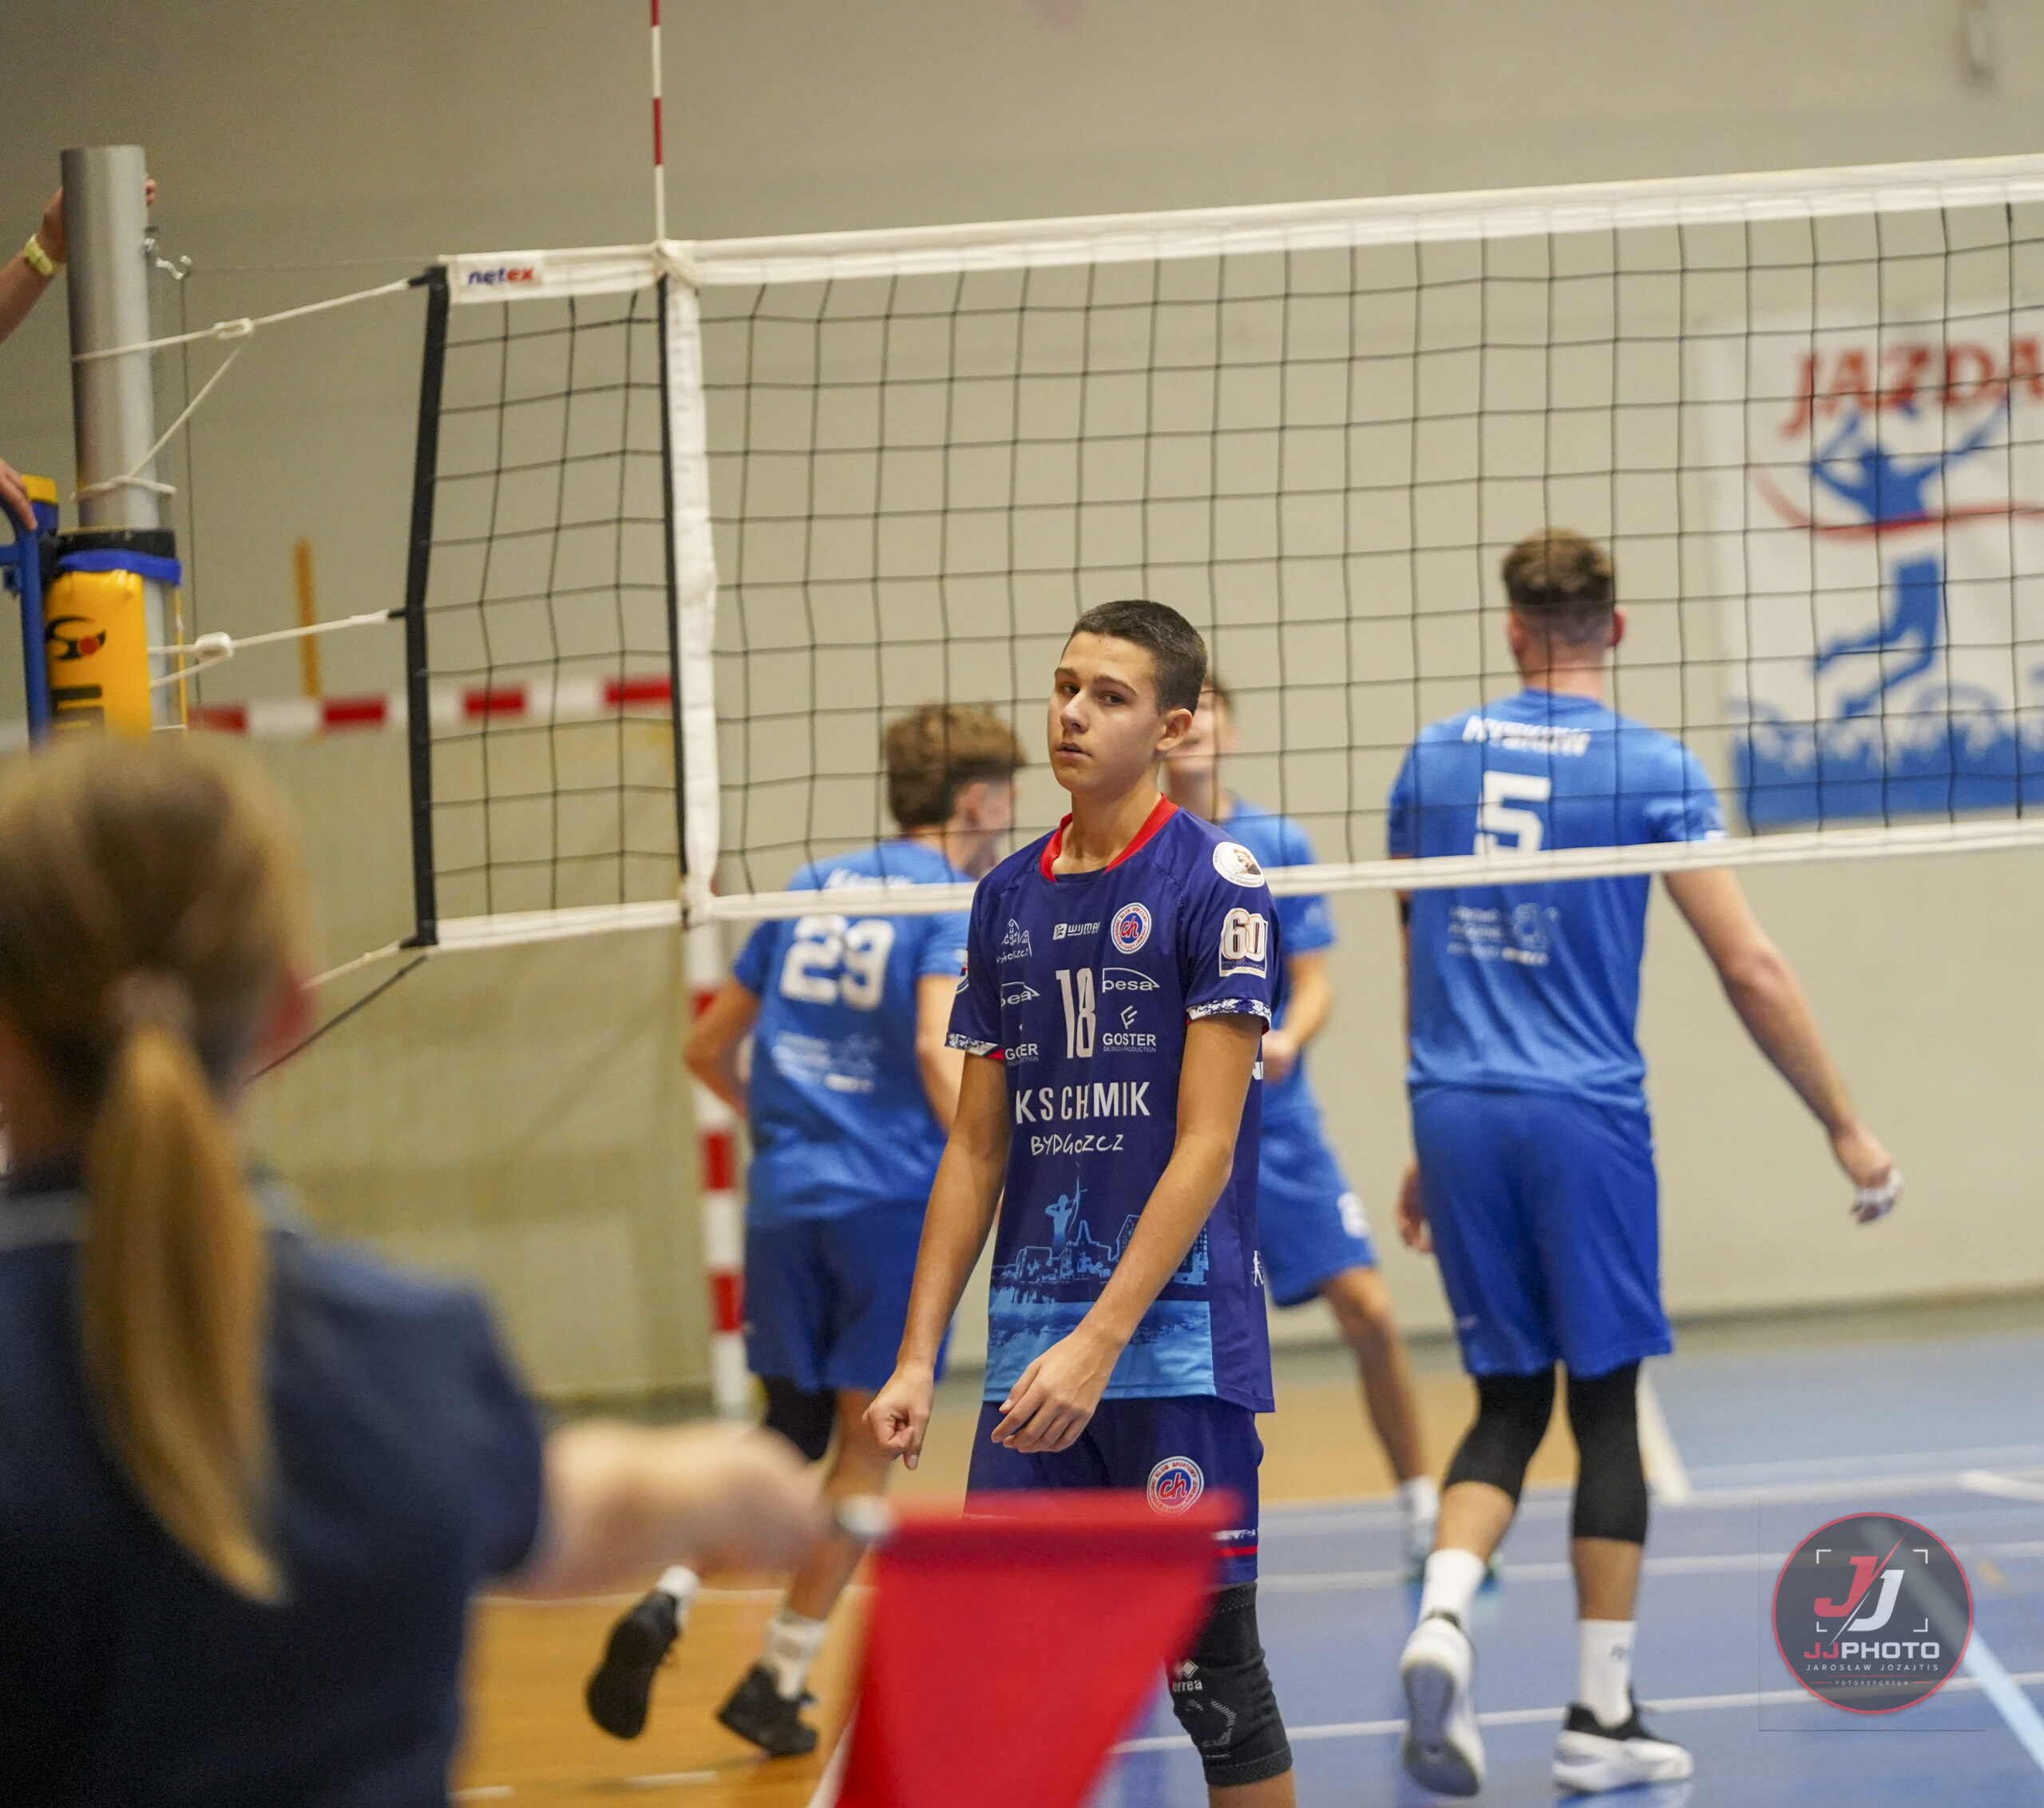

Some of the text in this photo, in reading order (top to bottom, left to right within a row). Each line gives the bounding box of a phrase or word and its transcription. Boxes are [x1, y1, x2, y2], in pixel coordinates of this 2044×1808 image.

[469, 267, 534, 285] netex
[1474, 770, 1551, 853] 5
[1221, 908, 1265, 962] 60
[1103, 979, 1153, 994] pesa
[1055, 967, 1096, 1059] 18
[1103, 1032, 1157, 1046] GOSTER
[1061, 1082, 1151, 1120] CHMIK
[1031, 1133, 1123, 1155] BYDGOZCZ
